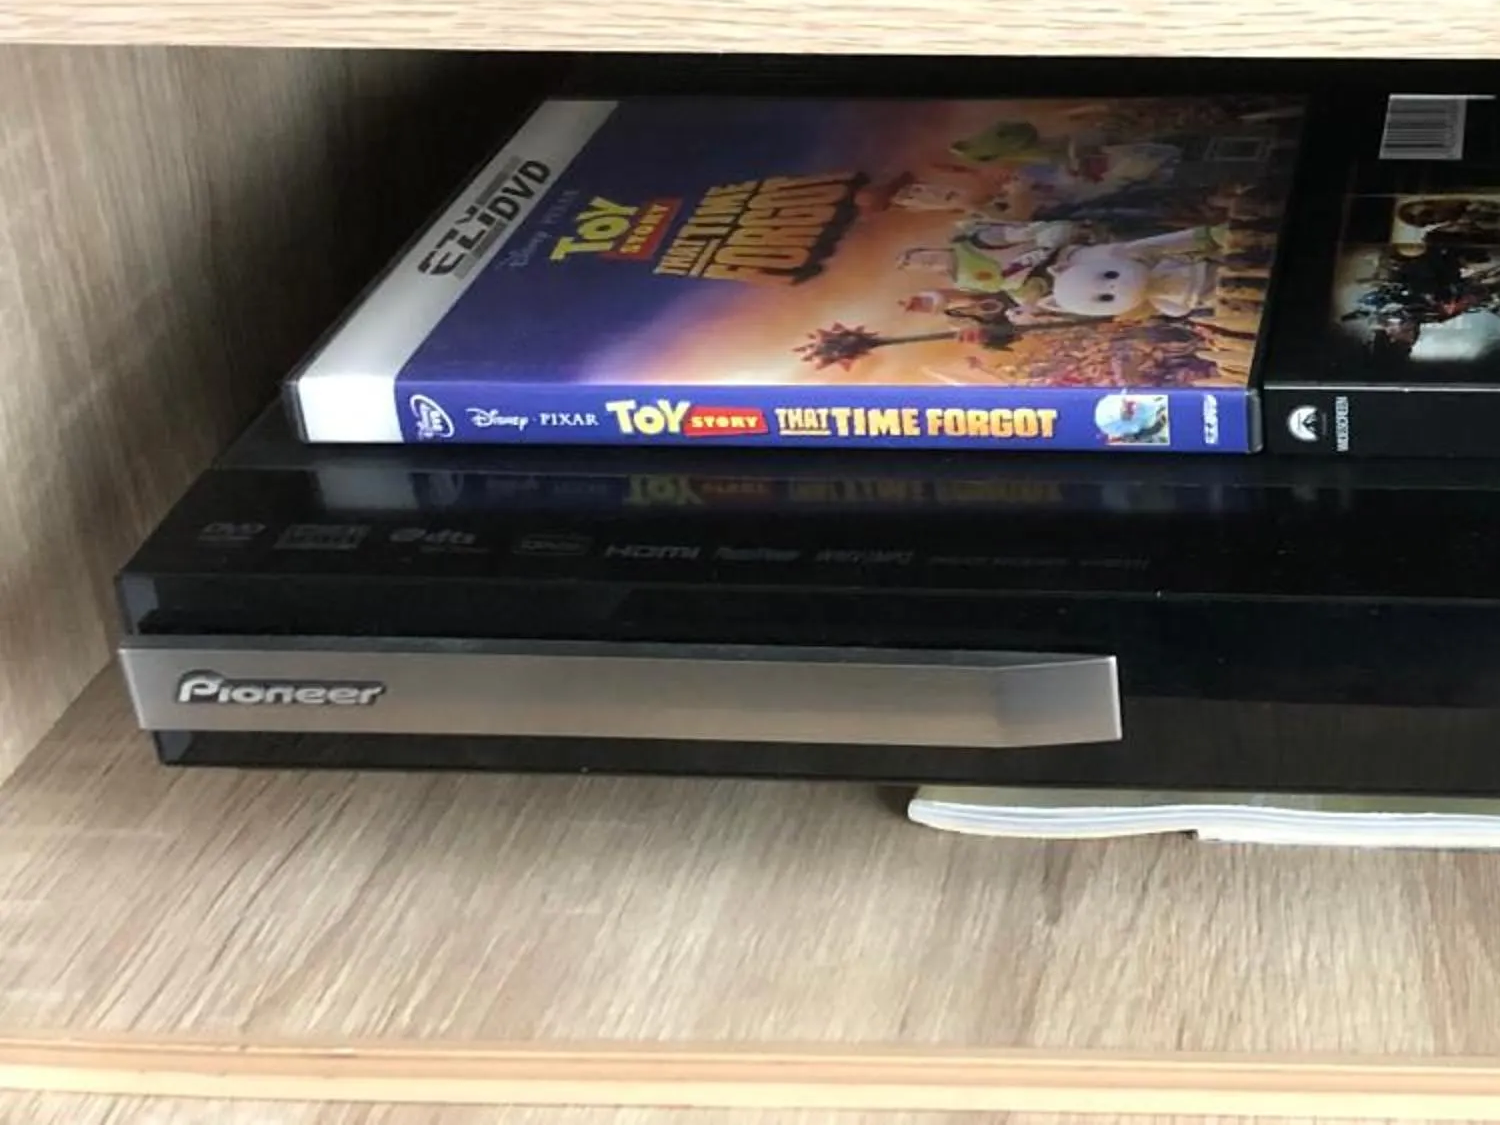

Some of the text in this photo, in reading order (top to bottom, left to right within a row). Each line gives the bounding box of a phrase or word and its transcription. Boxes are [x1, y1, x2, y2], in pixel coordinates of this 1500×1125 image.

[488, 160, 551, 221] DVD
[550, 196, 639, 261] TOY
[465, 407, 529, 431] Disney
[539, 412, 600, 427] PIXAR
[605, 399, 1058, 438] TOY STORY THAT TIME FORGOT
[605, 544, 702, 561] HDMI
[178, 675, 385, 707] Pioneer
